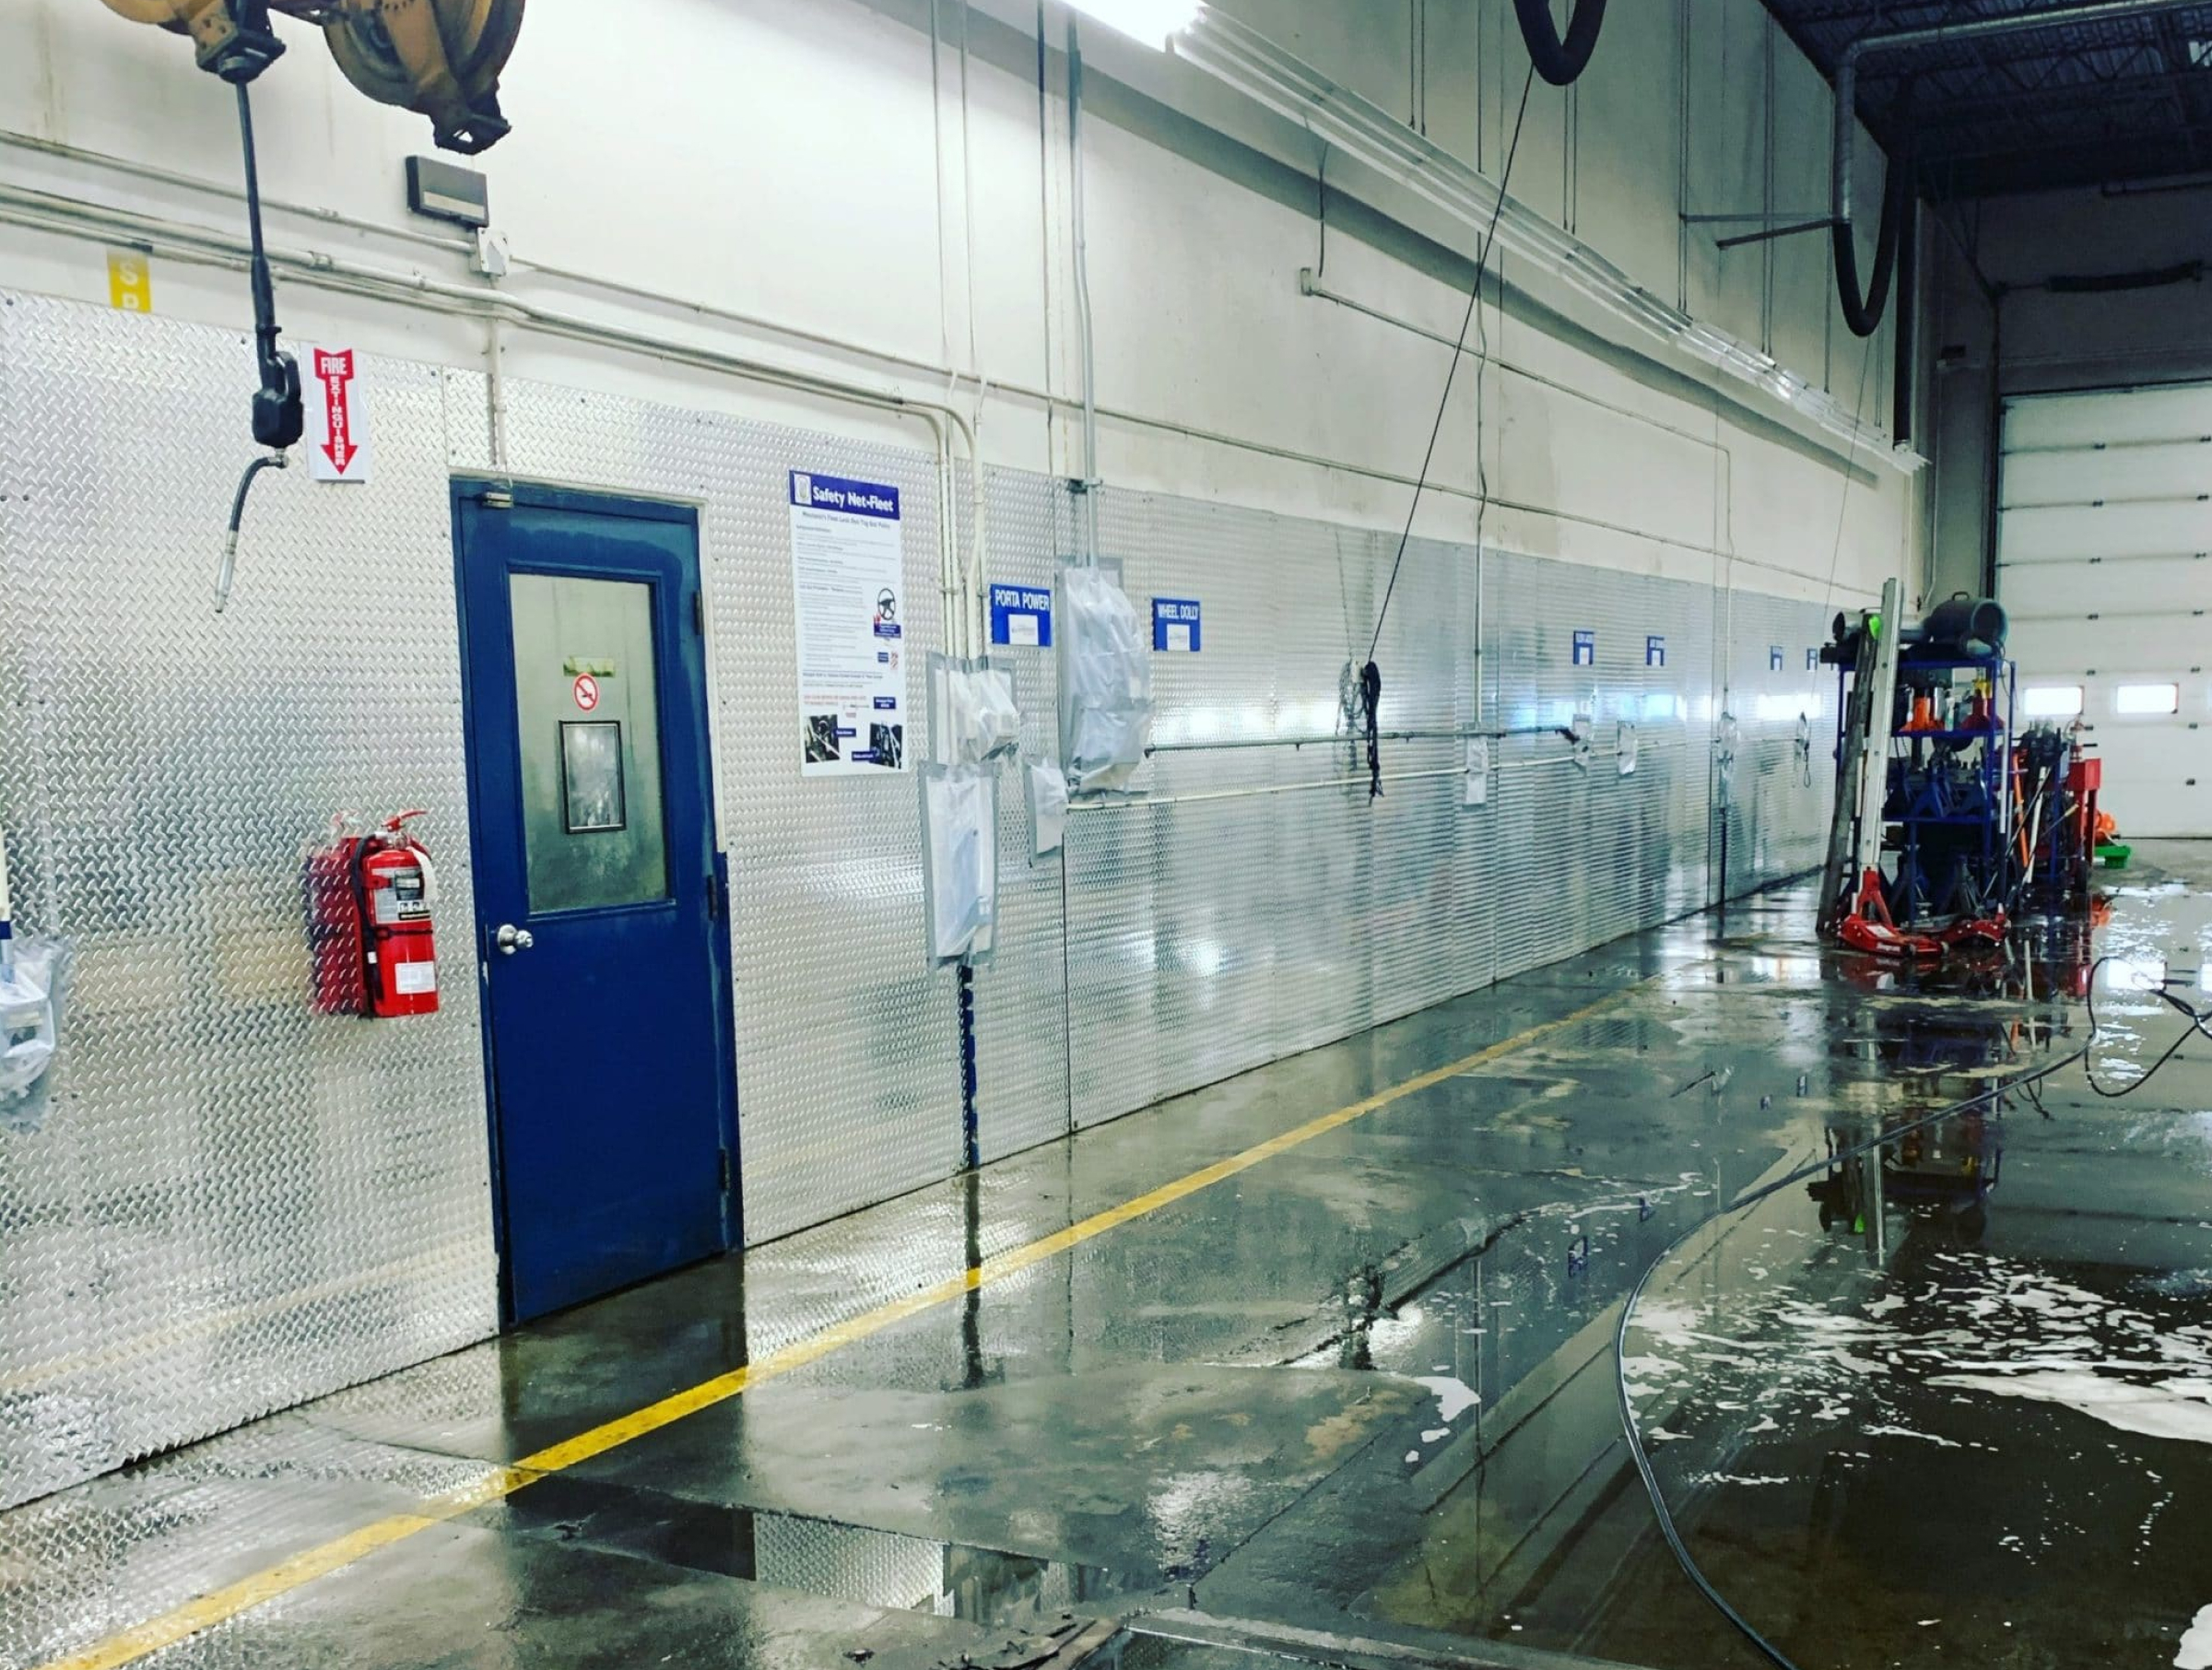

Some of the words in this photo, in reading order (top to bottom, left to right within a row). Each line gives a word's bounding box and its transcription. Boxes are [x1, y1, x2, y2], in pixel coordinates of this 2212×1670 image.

[320, 357, 347, 374] FIRE
[813, 486, 845, 509] Safety
[848, 491, 894, 512] Net-Fleet
[995, 589, 1020, 608] PORTA
[1022, 592, 1049, 612] POWER
[1157, 604, 1180, 619] WHEEL
